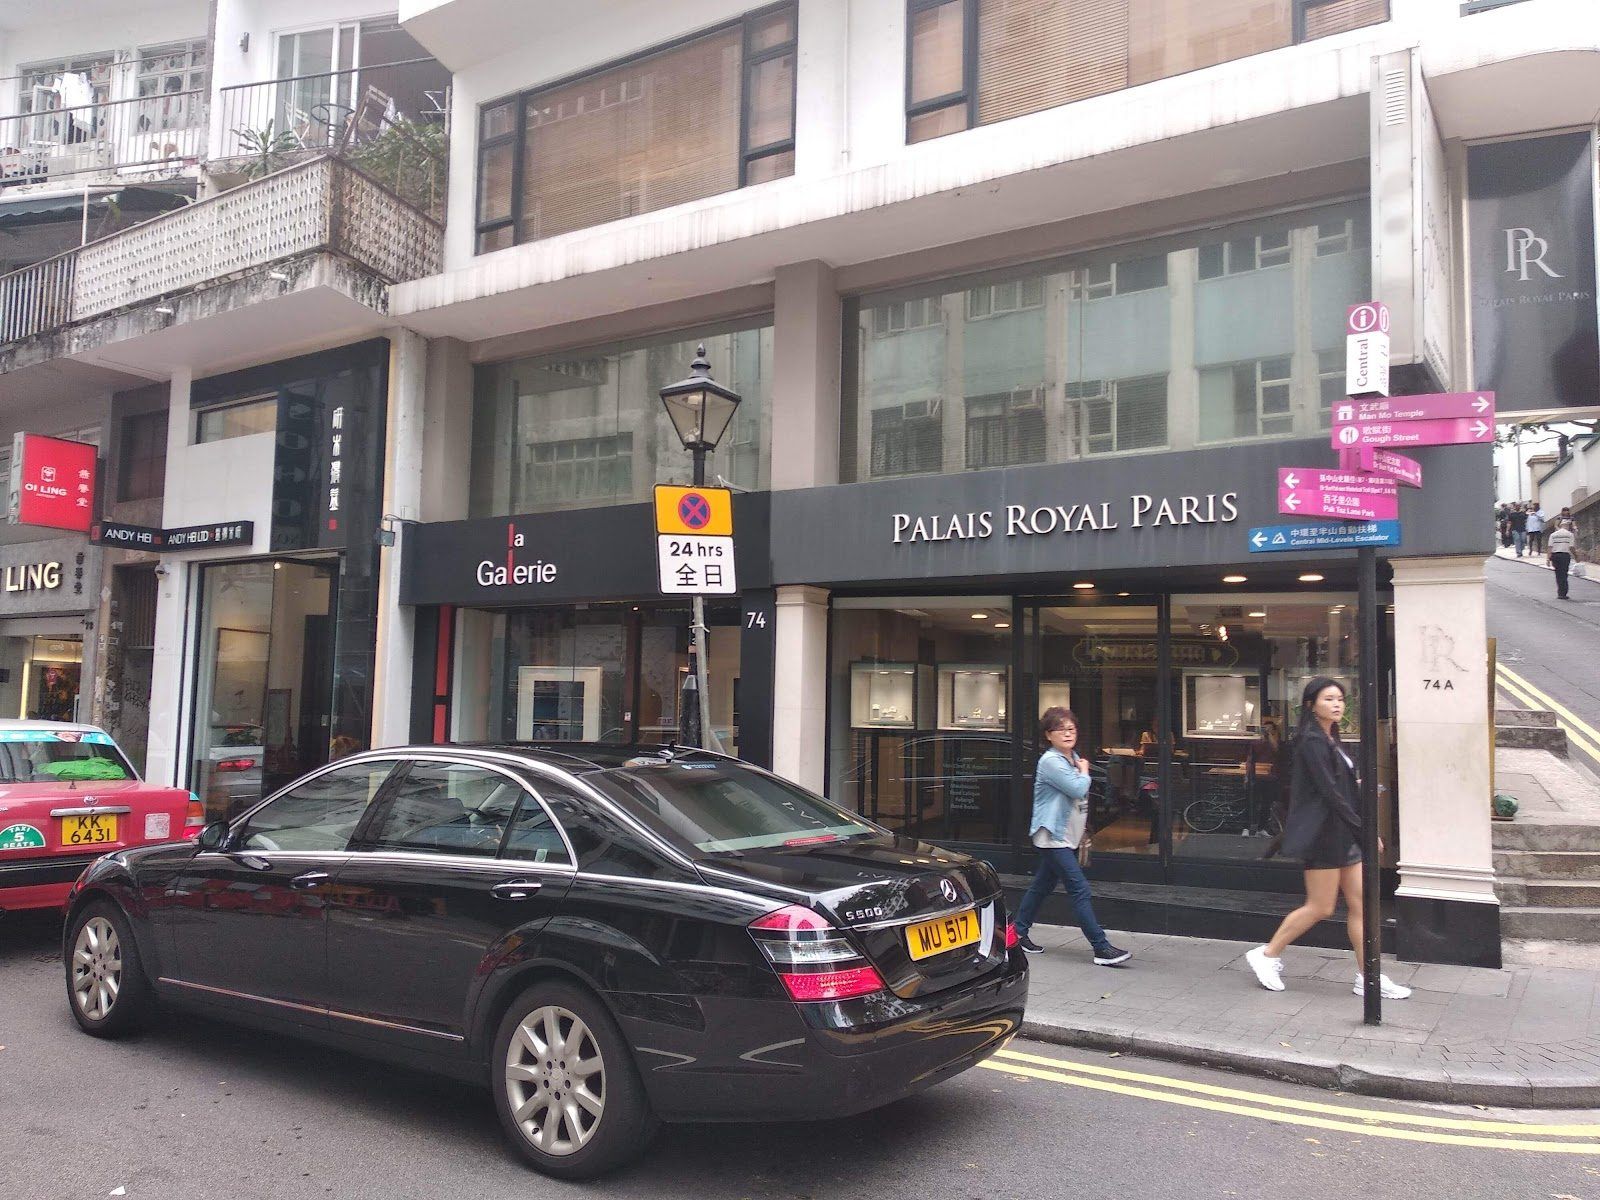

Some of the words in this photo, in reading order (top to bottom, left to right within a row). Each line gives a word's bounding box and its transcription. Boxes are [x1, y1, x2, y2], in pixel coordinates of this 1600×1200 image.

[1357, 338, 1369, 387] Central
[1378, 411, 1392, 419] Mo
[1393, 410, 1425, 418] Temple
[1362, 435, 1391, 443] Gough
[1392, 434, 1420, 442] Street
[40, 486, 68, 496] LING
[893, 511, 993, 543] PALAIS
[1005, 502, 1119, 537] ROYAL
[1130, 492, 1239, 528] PARIS
[104, 528, 136, 541] ANDY
[136, 532, 152, 544] HEI
[167, 533, 187, 546] ANDY
[1355, 534, 1390, 542] Escalator
[476, 549, 558, 587] Galerie
[675, 562, 724, 588] 全日
[6, 562, 60, 592] LING
[746, 611, 767, 629] 74
[1422, 679, 1454, 691] 74A
[9, 826, 31, 834] TAXI
[77, 815, 101, 830] KK
[14, 832, 25, 843] 5
[70, 828, 111, 844] 6431
[3, 841, 36, 849] SEATS
[918, 928, 942, 953] MU
[948, 915, 970, 944] 517
